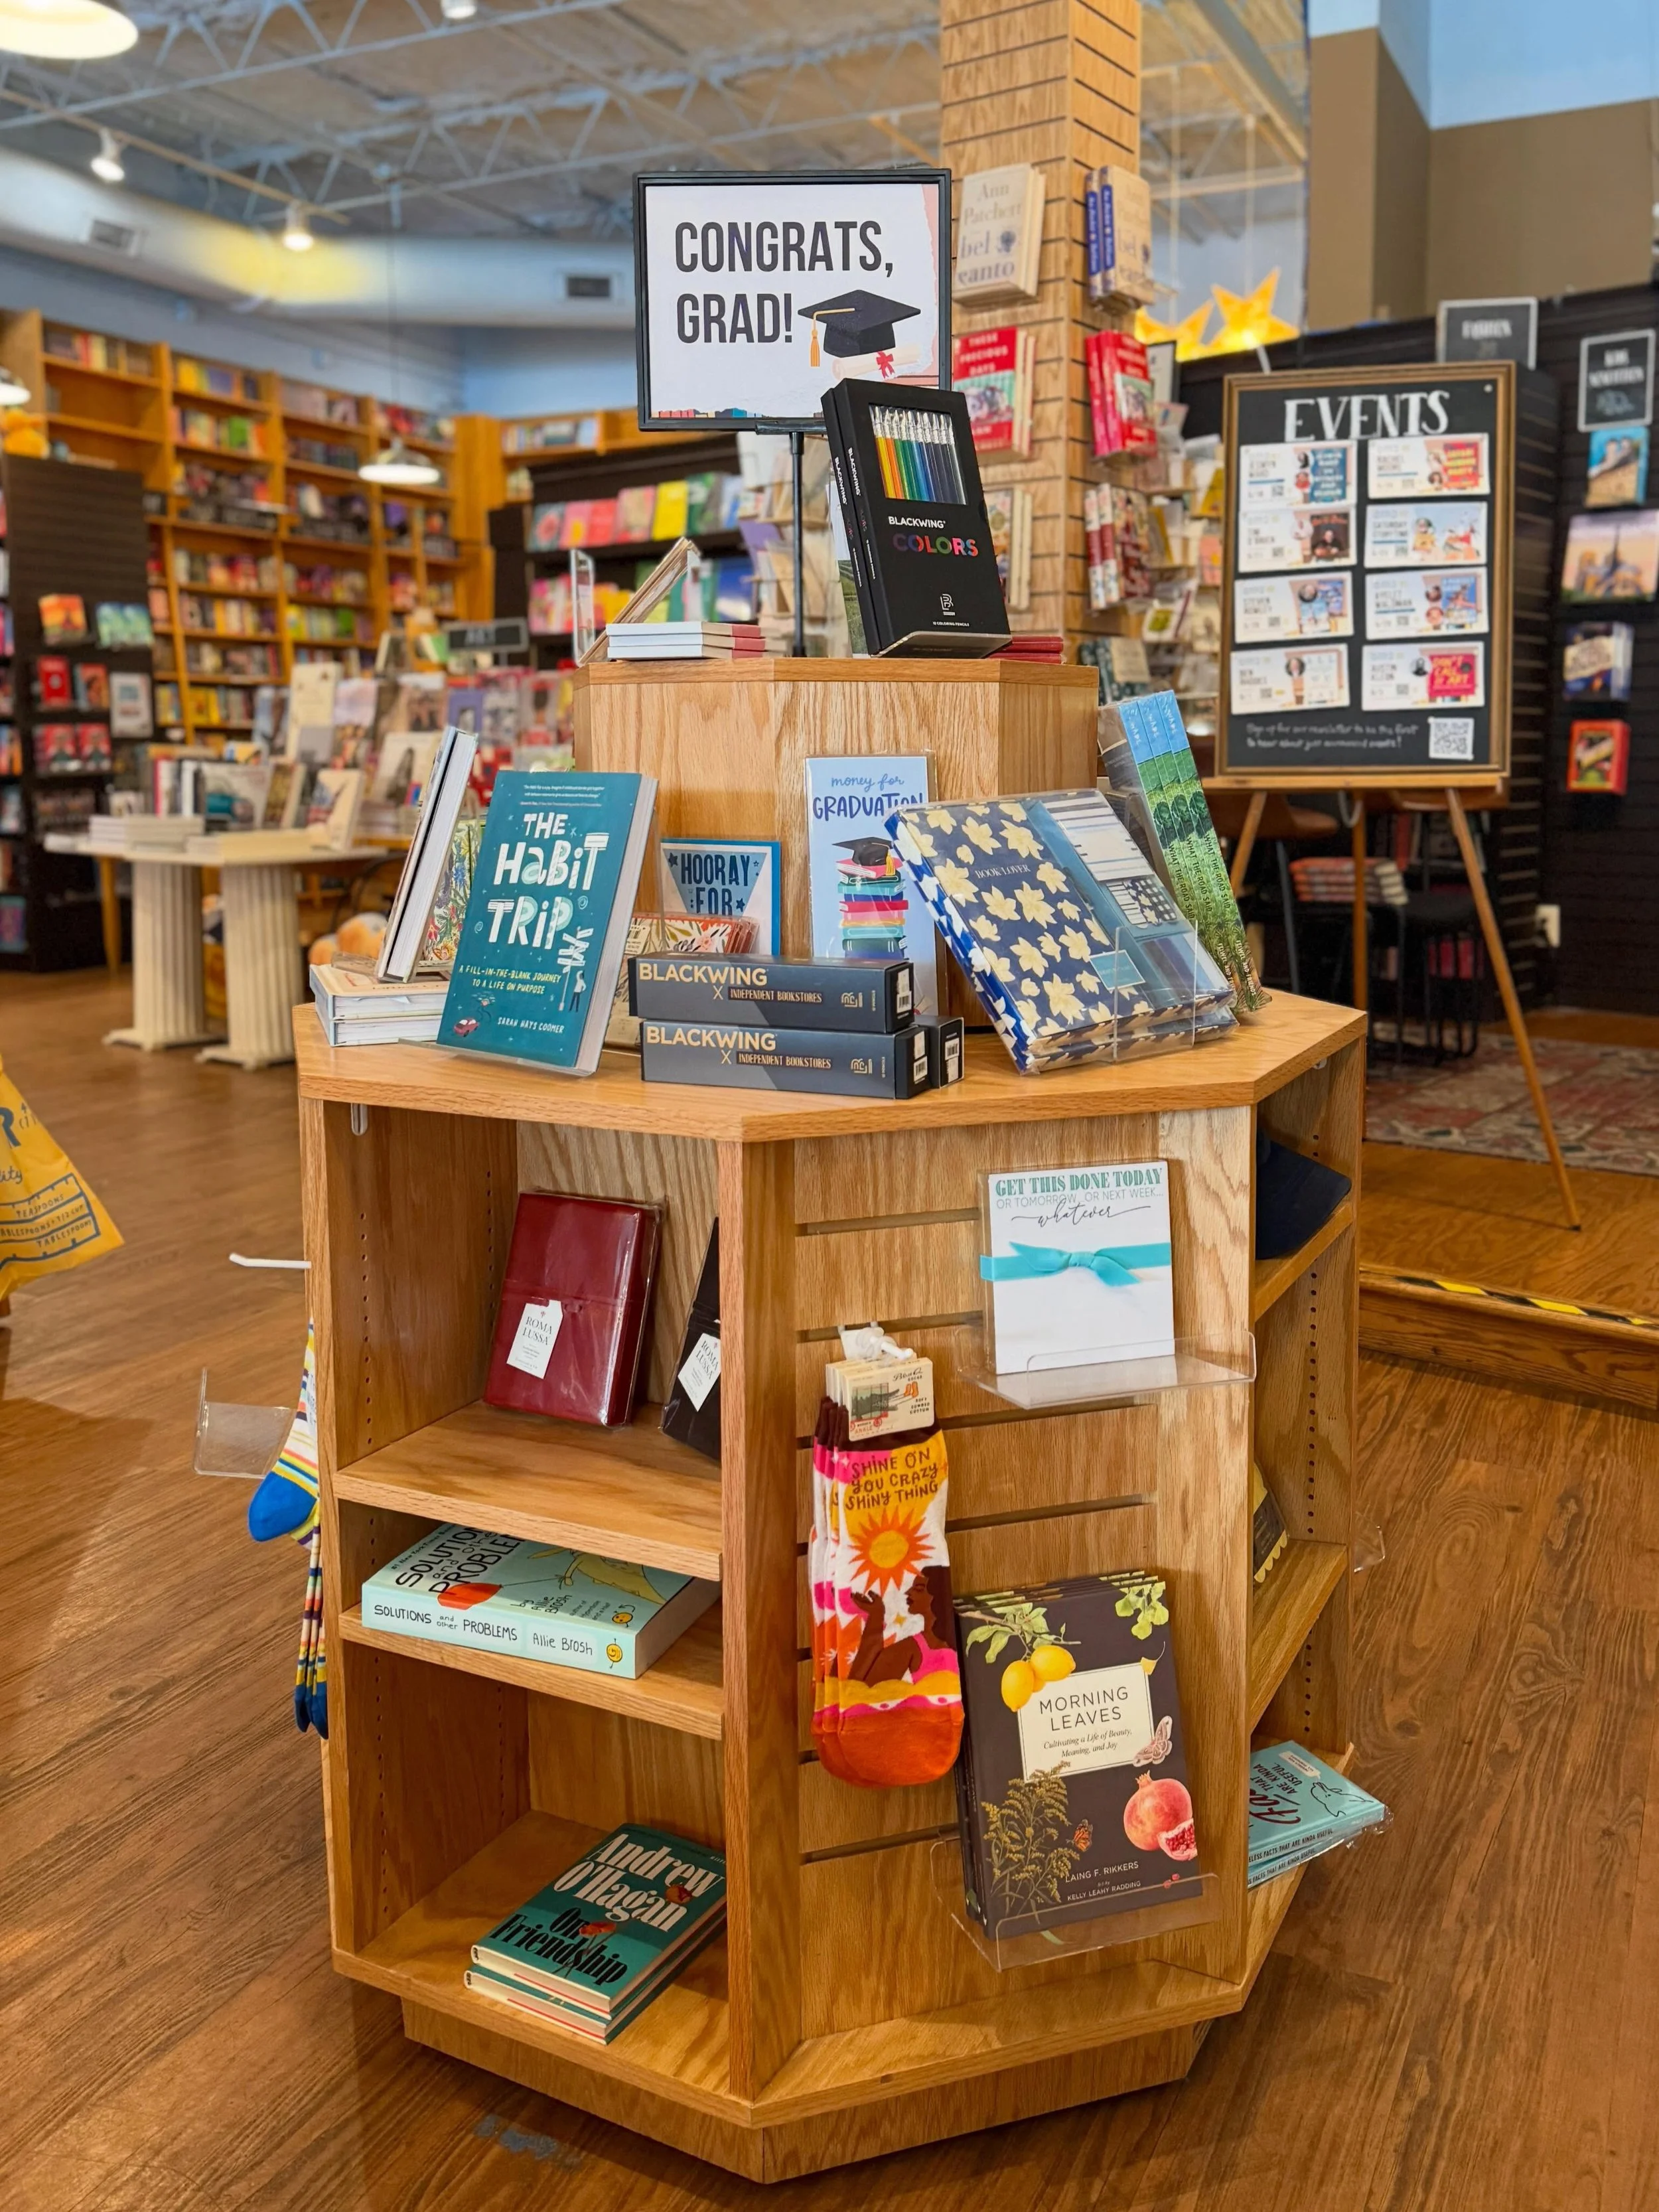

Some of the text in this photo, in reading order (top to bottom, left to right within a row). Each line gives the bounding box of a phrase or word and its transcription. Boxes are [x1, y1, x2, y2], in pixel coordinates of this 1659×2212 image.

[675, 220, 893, 277] CONGRATS,
[960, 230, 991, 259] bel
[957, 260, 1015, 286] canto
[677, 293, 792, 344] GRAD!
[1284, 390, 1450, 443] EVENTS
[835, 457, 847, 504] BLACKWING
[848, 447, 860, 496] BLACKWING
[888, 516, 946, 528] BLACKWING
[893, 532, 979, 557] COLORS
[831, 773, 904, 792] money for
[523, 812, 569, 839] THE
[680, 852, 751, 887] HOORAY
[975, 864, 1031, 879] BOOK LOVER
[1169, 844, 1195, 919] WHAT THE ROAD SAID
[1187, 836, 1213, 912] WHAT THE ROAD SAID
[1204, 834, 1231, 909] WHAT THE ROAD SAID
[696, 888, 733, 915] FOR
[459, 965, 562, 984] A FILL-IN-THE-BLANK JOURNEY
[638, 963, 768, 986] BLACKWING
[488, 981, 505, 990] LIFE
[516, 984, 545, 994] PURPOSE
[730, 988, 774, 1001] INDEPENDENT
[776, 990, 823, 1003] BOOKSTORES
[498, 1017, 565, 1033] SARAH HAYS COOMER
[646, 1026, 776, 1051] BLACKWING
[738, 1053, 784, 1066] INDEPENDENT
[786, 1055, 831, 1069] BOOKSTORES
[995, 1167, 1163, 1197] GET THIS DONE TODAY
[16, 1194, 65, 1218] TEASPOONS
[996, 1199, 1011, 1209] OR
[1103, 1189, 1126, 1201] NEXT
[0, 1220, 50, 1238] ABLESPOONS
[36, 1218, 92, 1248] TABLESPOONS
[522, 1327, 549, 1345] LUSSA
[526, 1316, 553, 1335] ROMA
[695, 1350, 715, 1380] LUSSA
[701, 1341, 719, 1371] ROMA
[905, 1447, 930, 1469] ON
[396, 1526, 483, 1587] SOLUTIO
[428, 1534, 526, 1593] PROBLE
[432, 1532, 498, 1579] and othe
[510, 1599, 534, 1608] by
[532, 1595, 554, 1611] Allie
[545, 1594, 573, 1614] Brosh
[374, 1605, 432, 1624] SOLUTIONS
[463, 1619, 518, 1641] PROBLEMS
[533, 1633, 593, 1656] Allie Brosh
[1040, 1686, 1128, 1714] MORNING
[1050, 1706, 1121, 1731] LEAVES
[1044, 1737, 1079, 1749] Cultivating
[1087, 1732, 1100, 1742] Life
[1100, 1730, 1108, 1739] of
[1109, 1728, 1132, 1739] Beauty,
[1062, 1741, 1118, 1758] Meaning, and Joy
[1253, 1763, 1281, 1782] KINDA
[1271, 1762, 1303, 1786] USEFUL
[1276, 1781, 1298, 1794] ARE
[1249, 1852, 1262, 1863] ELESS
[1263, 1847, 1278, 1858] FACTS
[1302, 1835, 1316, 1844] KINDA
[1317, 1828, 1333, 1839] USEFUL
[586, 1833, 725, 1898] Andrew
[1066, 1870, 1092, 1883] LAING
[1104, 1861, 1139, 1875] RIKKERS
[1252, 1872, 1265, 1882] FACTS
[1267, 1867, 1277, 1876] THAT
[1287, 1856, 1300, 1866] KINDA
[553, 1861, 688, 1933] O'Hagan
[1067, 1880, 1141, 1901] KELLY LEAHY RADDING
[549, 1907, 593, 1939] On
[488, 1912, 628, 1986] Friendship
